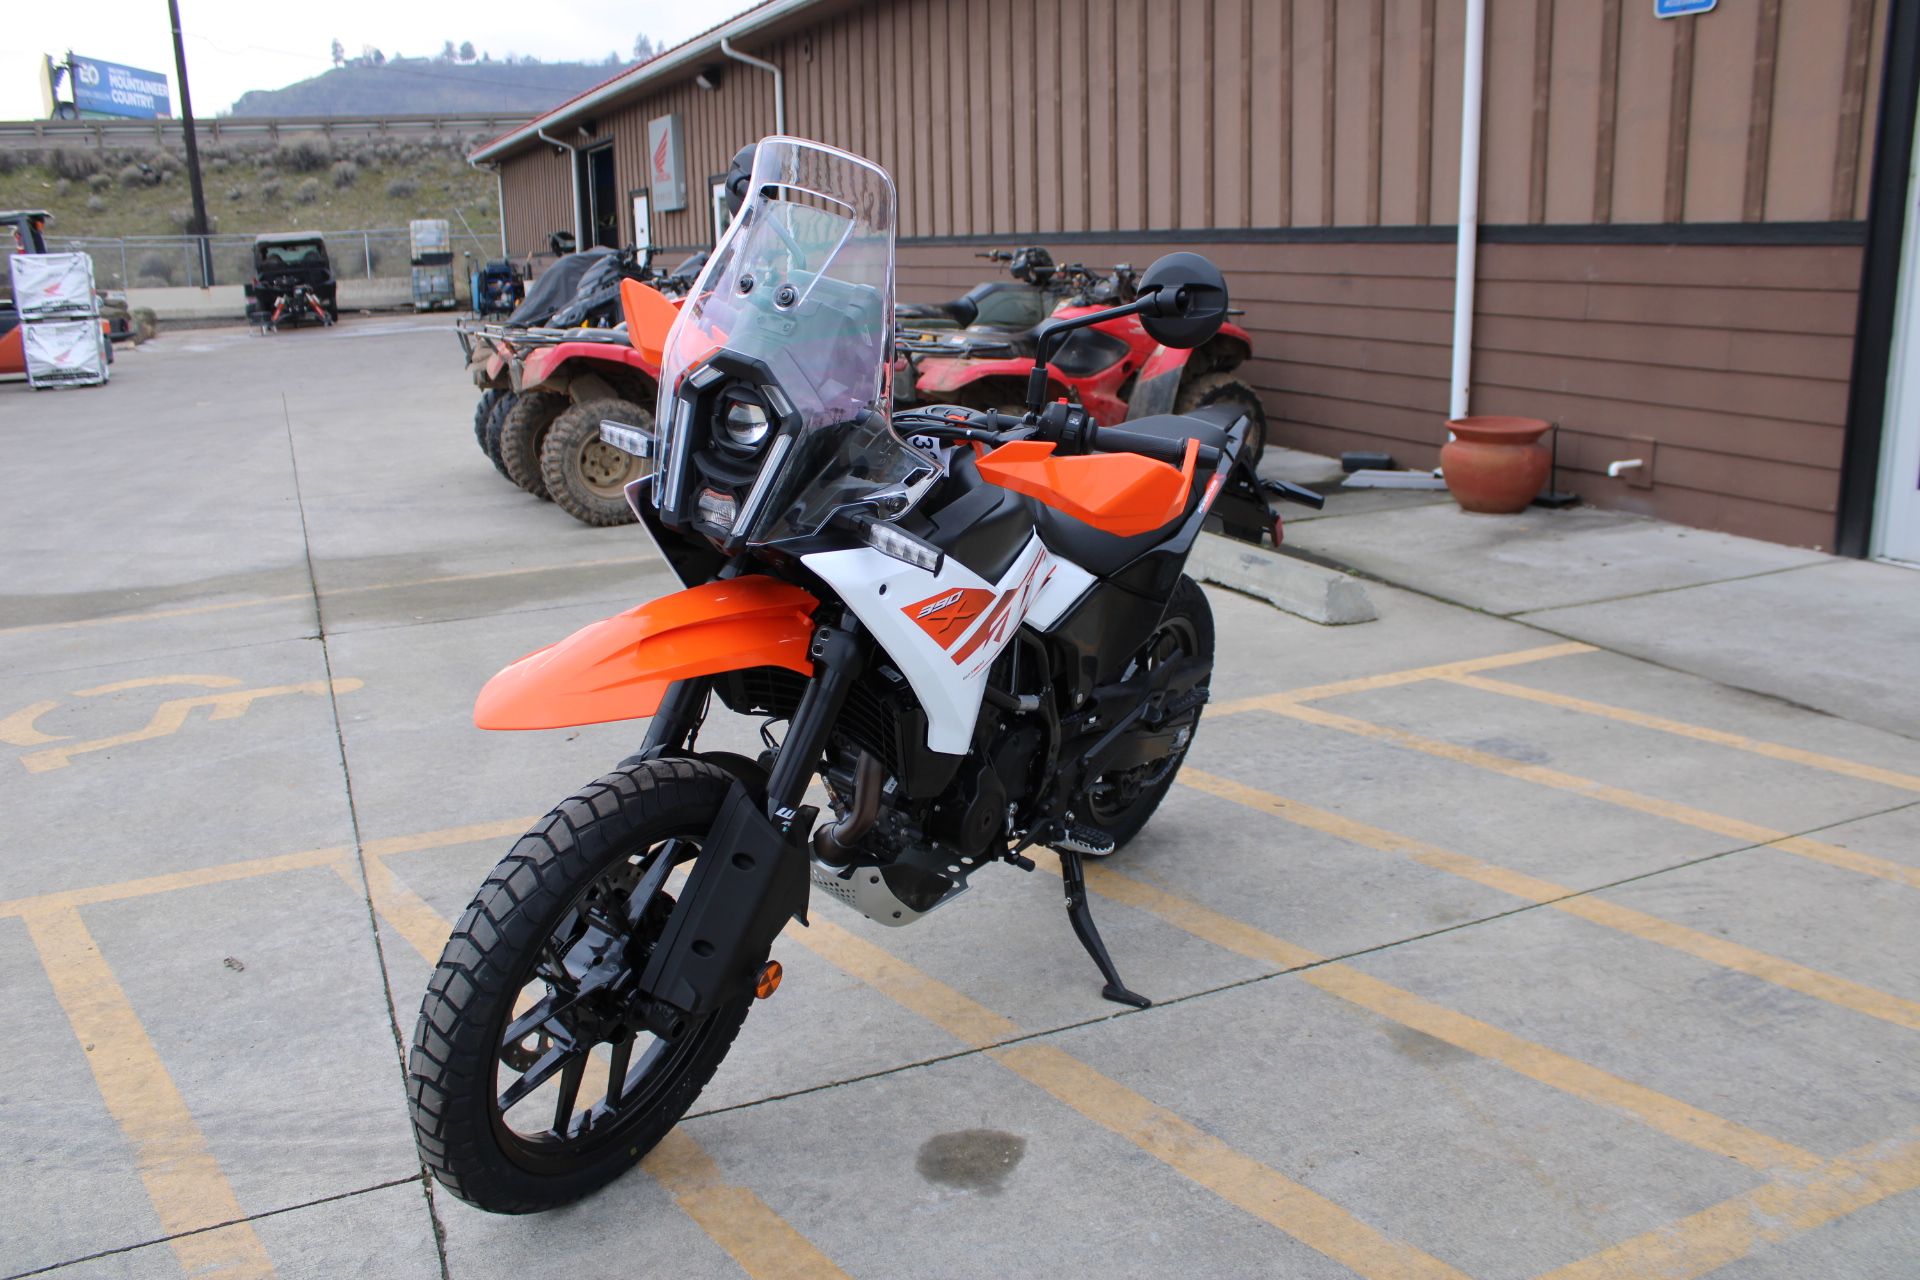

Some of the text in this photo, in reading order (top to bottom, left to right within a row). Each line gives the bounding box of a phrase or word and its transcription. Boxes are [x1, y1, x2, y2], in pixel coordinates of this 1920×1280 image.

[108, 74, 168, 98] MOUNTAINEER
[111, 88, 155, 110] COUNTRY!
[916, 589, 964, 620] 390
